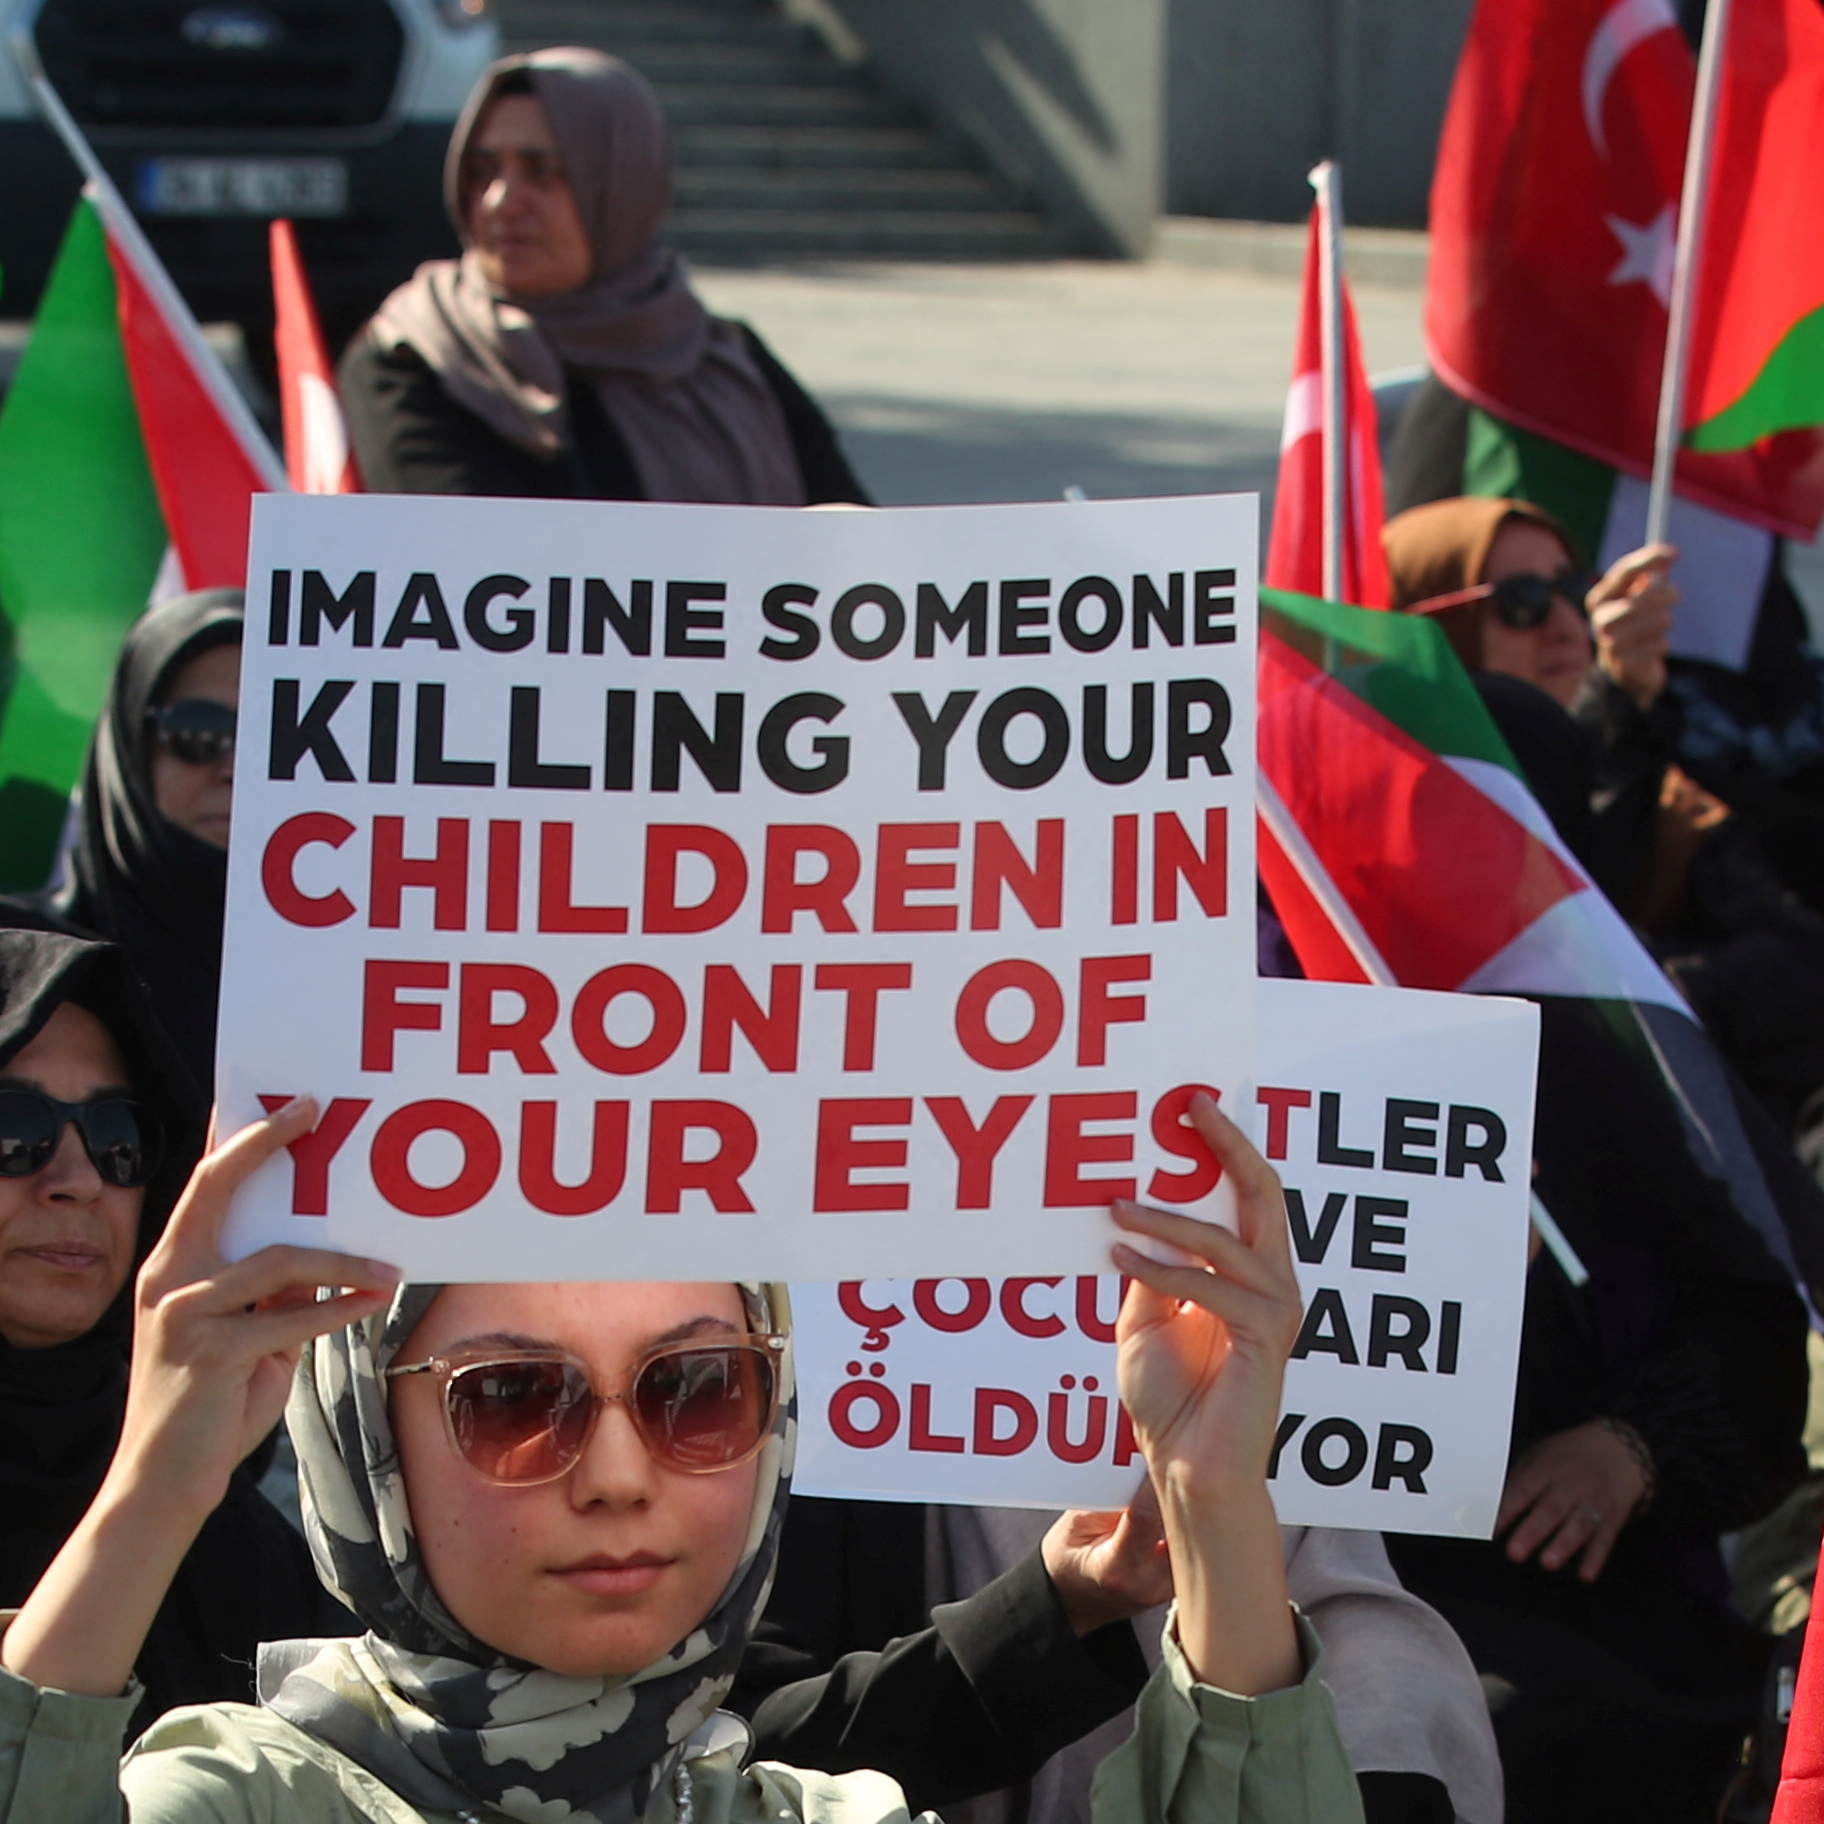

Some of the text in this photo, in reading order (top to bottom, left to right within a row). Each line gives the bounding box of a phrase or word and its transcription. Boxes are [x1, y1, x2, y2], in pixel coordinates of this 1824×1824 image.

[268, 569, 1236, 661] IMAGINE SOMEONE
[268, 679, 1232, 794] KILLING YOUR
[261, 807, 1227, 934] CHILDREN IN
[361, 954, 1151, 1075] FRONT OF
[259, 1084, 1222, 1217] YOUR EYES
[1282, 1188, 1408, 1273] VE
